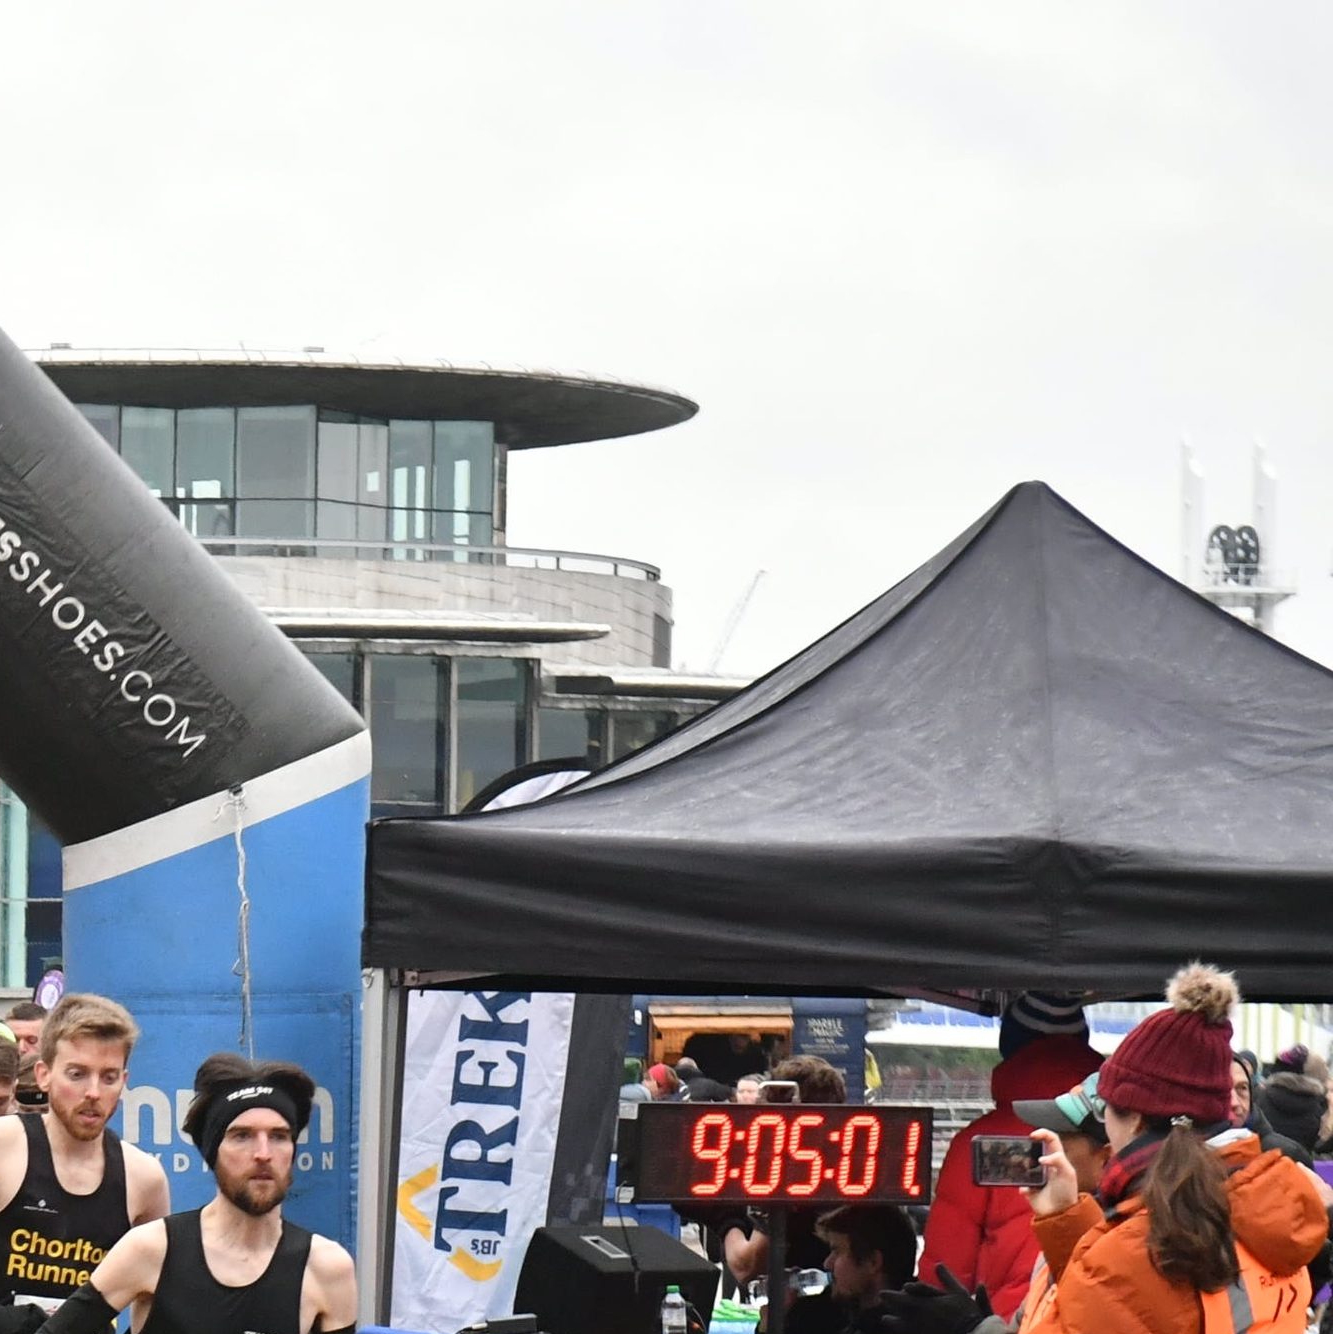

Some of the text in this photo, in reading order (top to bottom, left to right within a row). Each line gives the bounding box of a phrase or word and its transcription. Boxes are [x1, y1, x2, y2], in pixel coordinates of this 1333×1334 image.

[434, 992, 532, 1252] TREK
[10, 1228, 108, 1265] Chorlto
[6, 1253, 92, 1286] Runne
